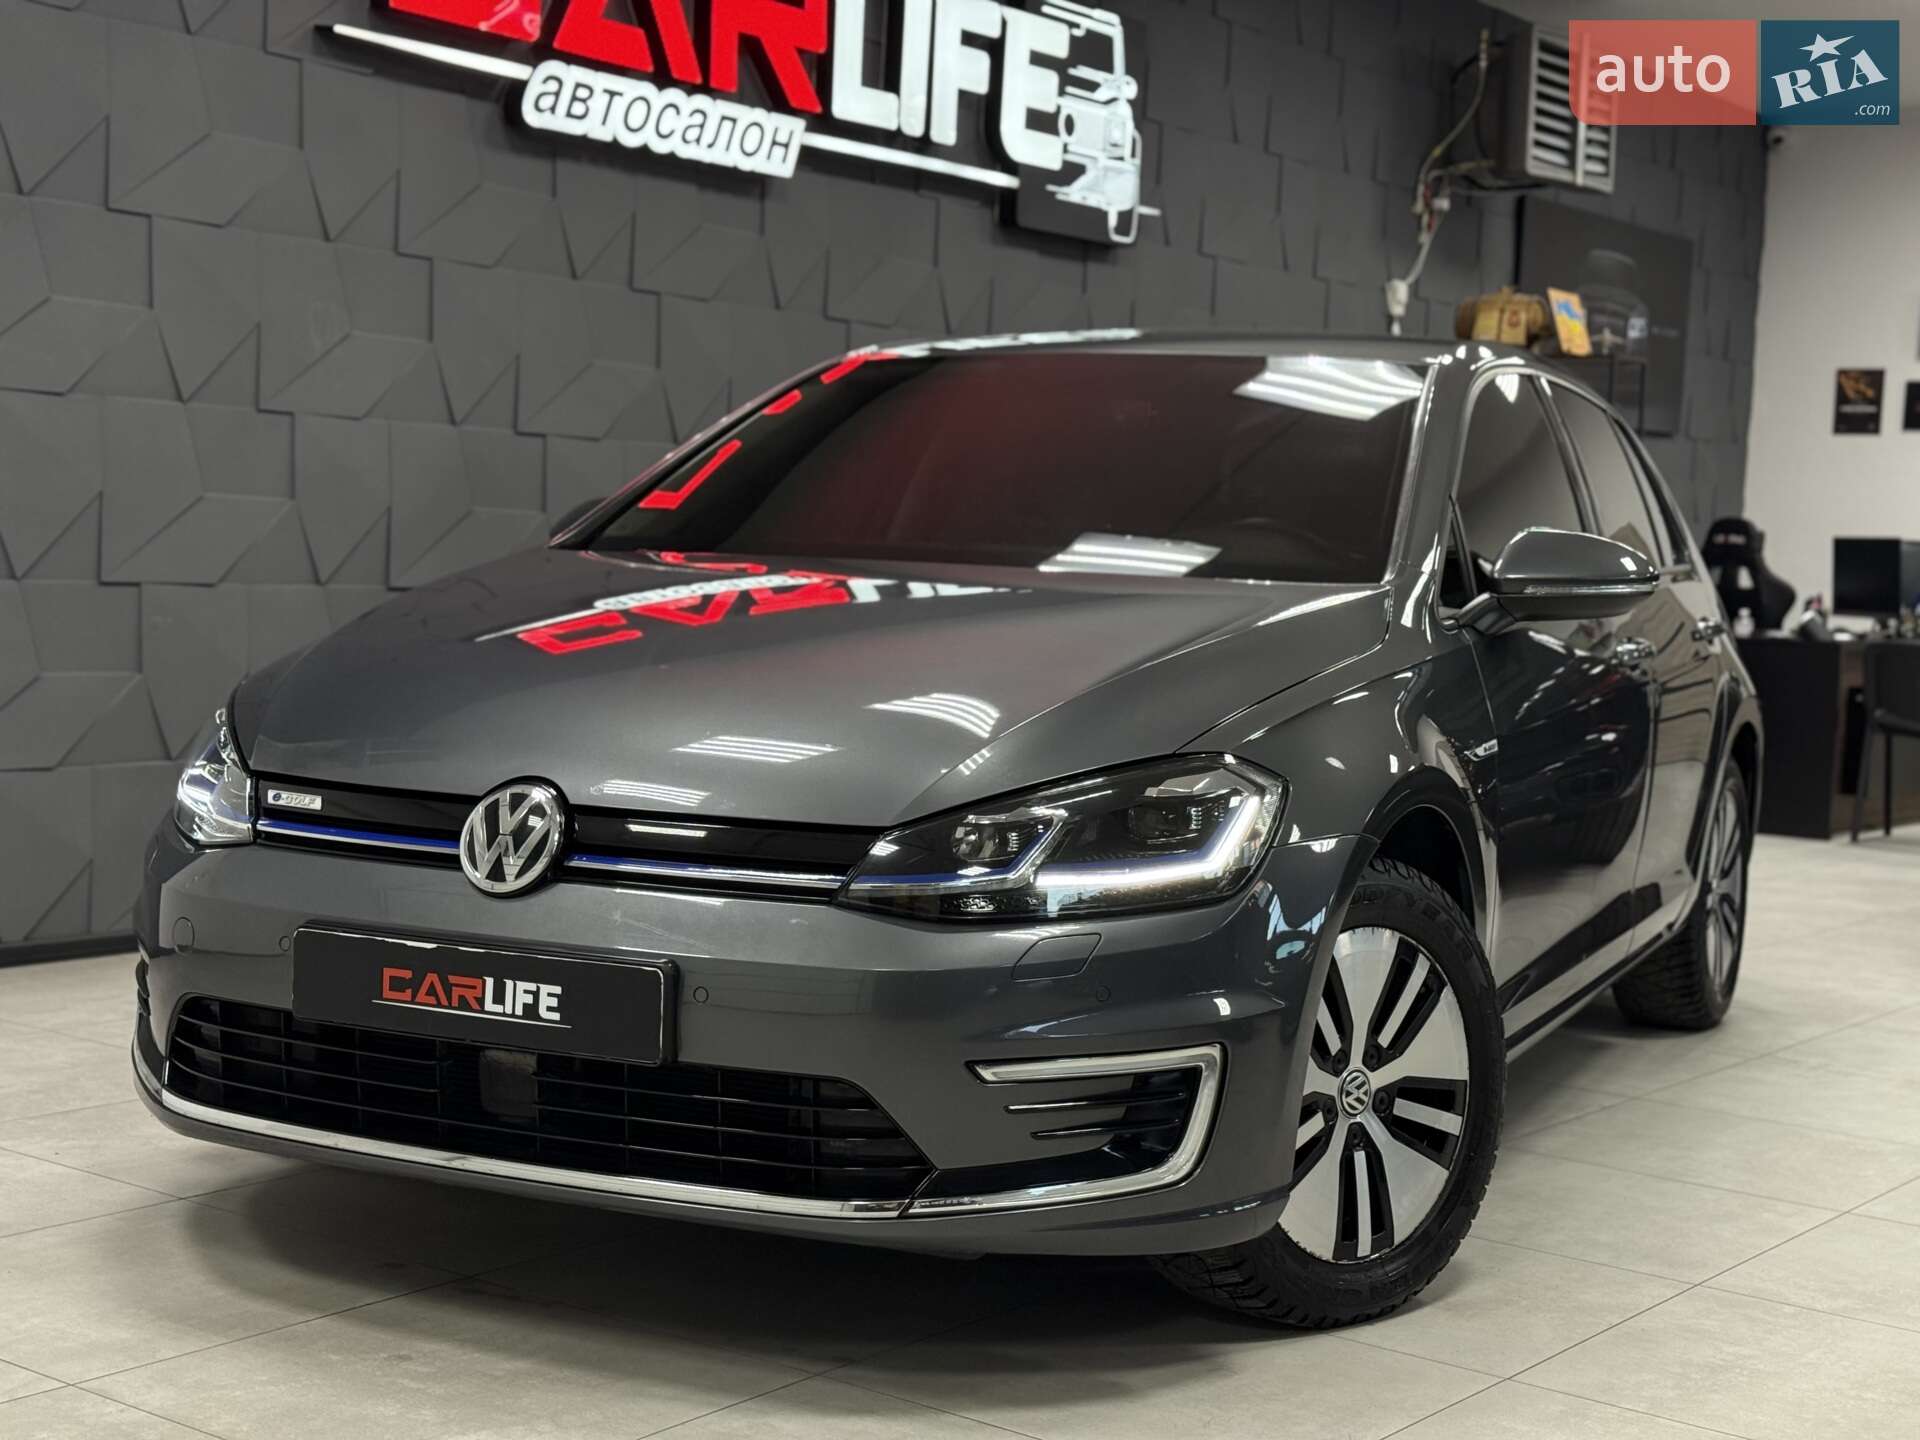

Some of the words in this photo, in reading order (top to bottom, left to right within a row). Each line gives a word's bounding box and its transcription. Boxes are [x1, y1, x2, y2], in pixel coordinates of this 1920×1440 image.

[532, 73, 794, 165] автосалон
[460, 784, 563, 893] VW
[382, 967, 562, 1021] CARLIFE
